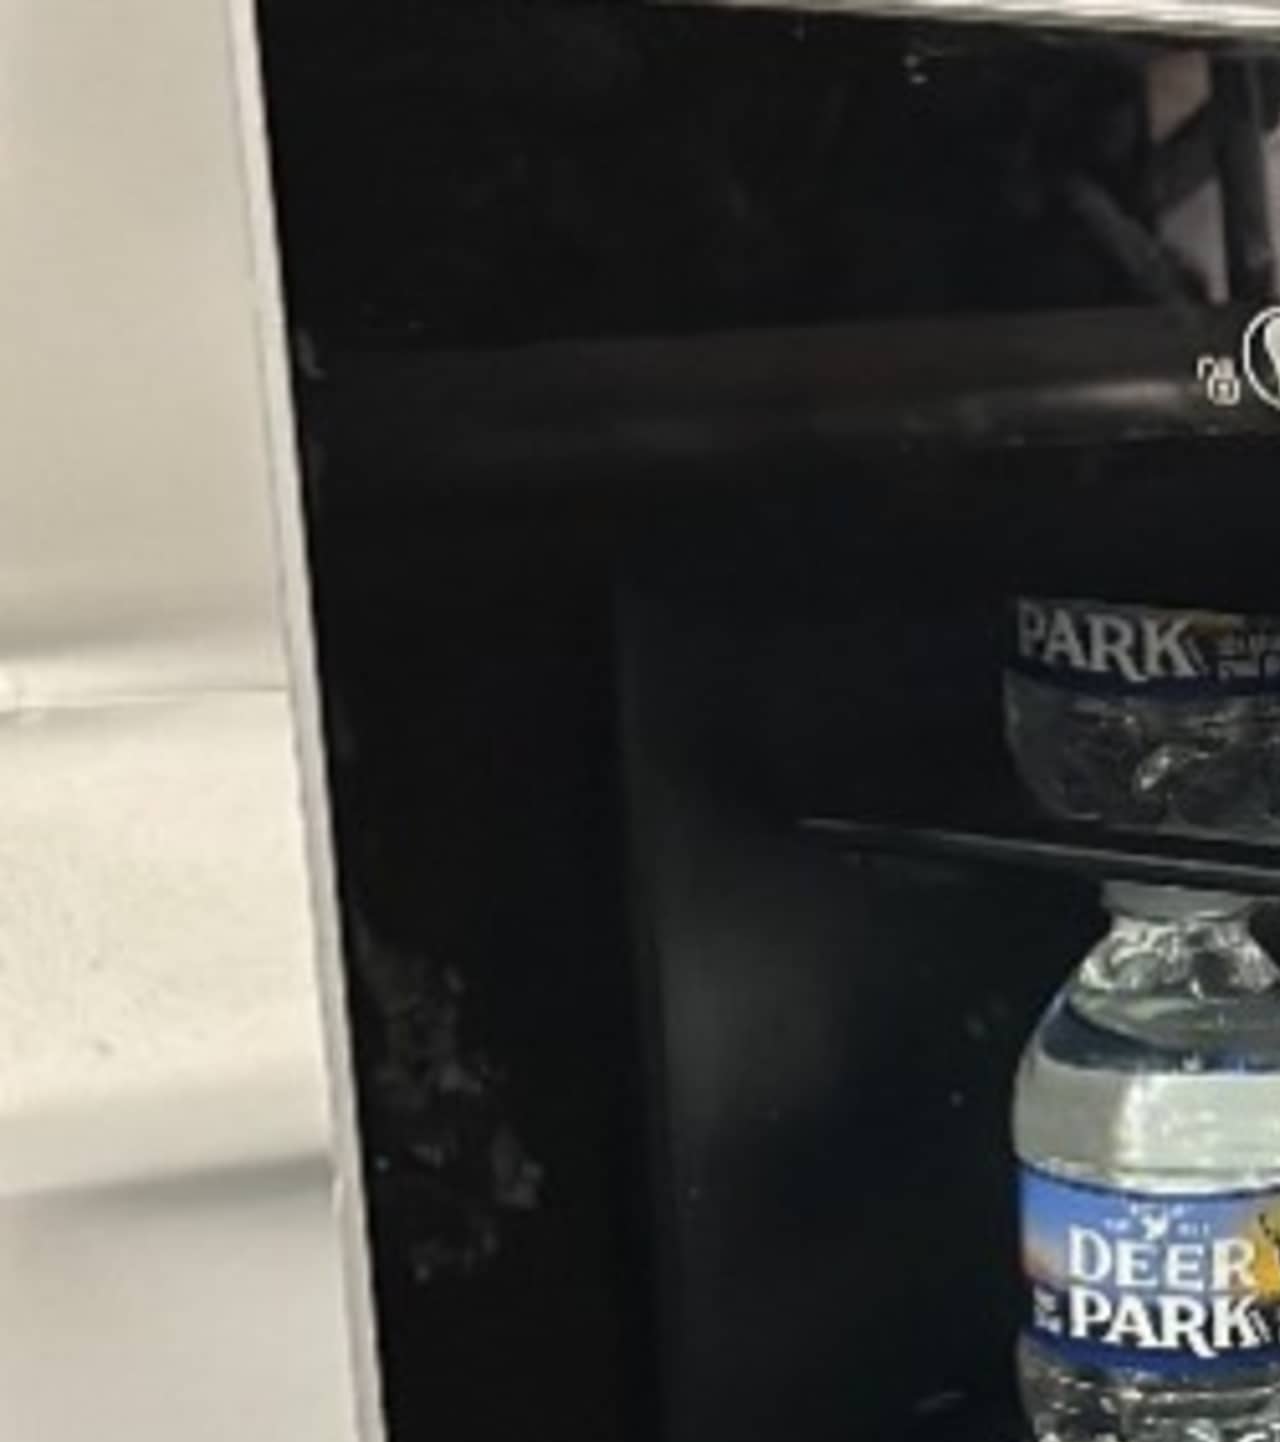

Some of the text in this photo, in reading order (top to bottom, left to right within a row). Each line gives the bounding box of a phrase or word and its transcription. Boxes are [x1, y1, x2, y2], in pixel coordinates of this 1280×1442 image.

[1018, 601, 1197, 683] PARK
[1067, 1223, 1257, 1291] DEER
[1067, 1286, 1262, 1358] PARK
